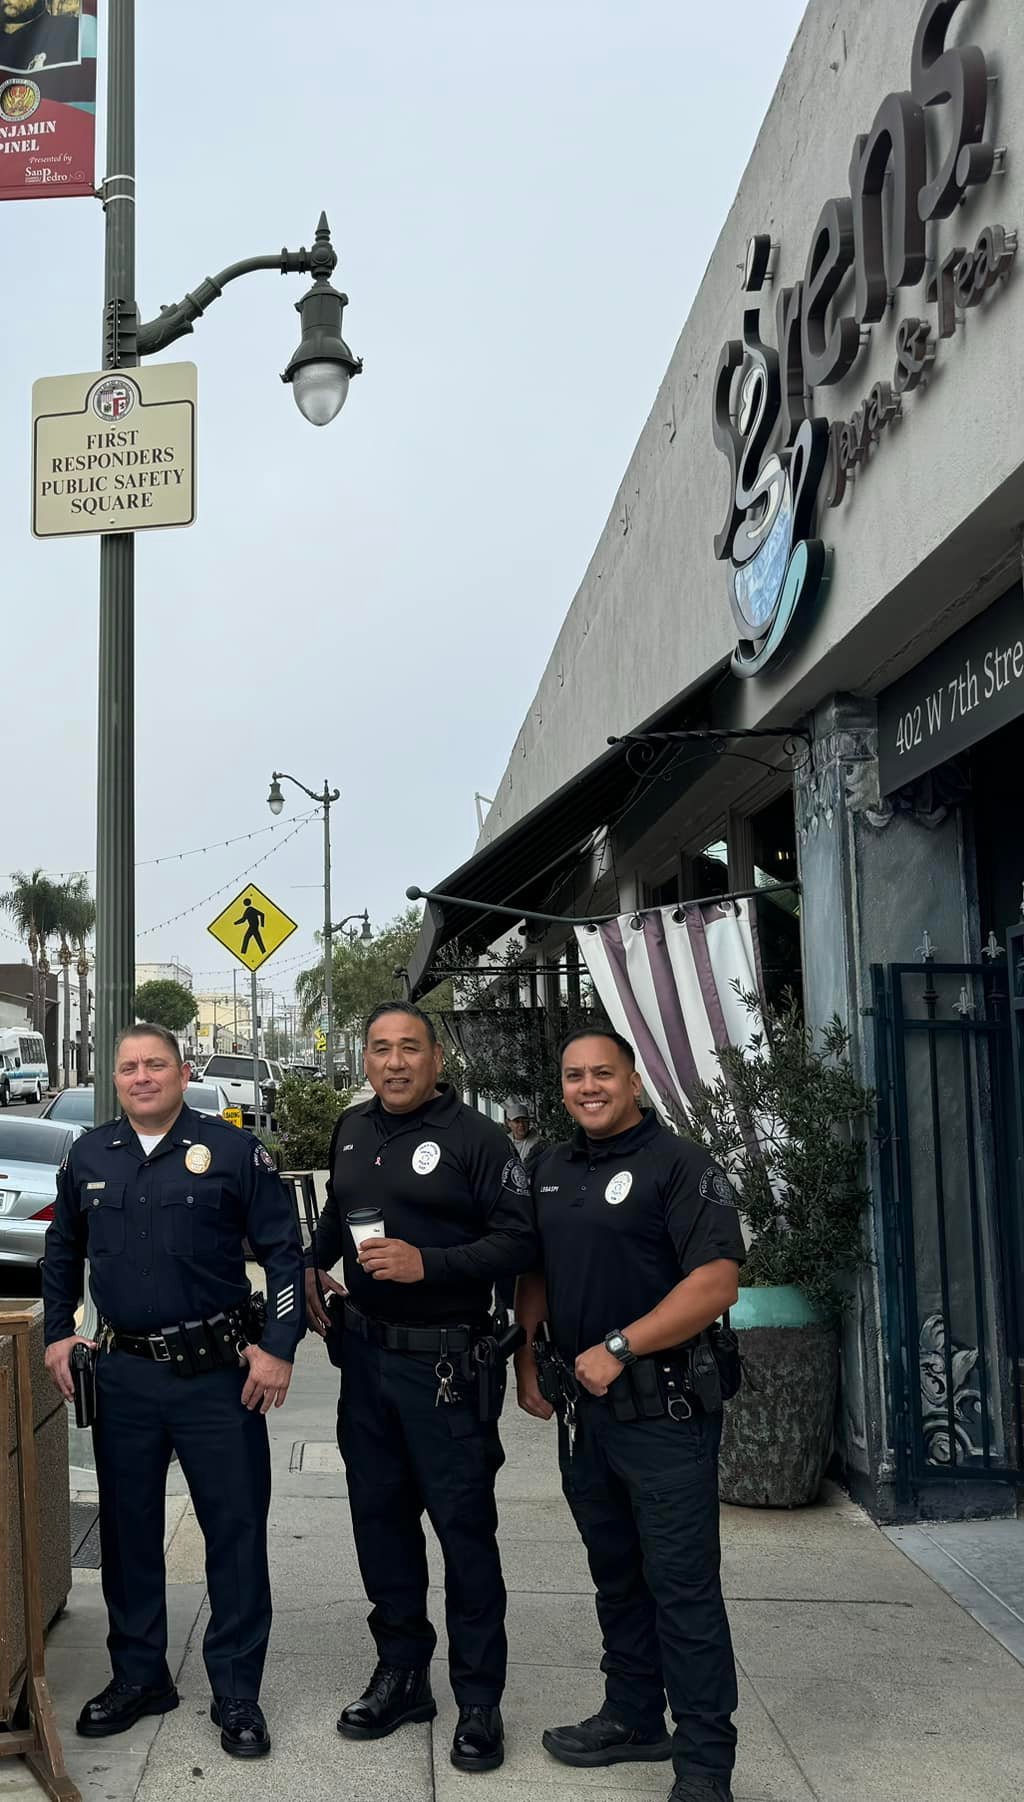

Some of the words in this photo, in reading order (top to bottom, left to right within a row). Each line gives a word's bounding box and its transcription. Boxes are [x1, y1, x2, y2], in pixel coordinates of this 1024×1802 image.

[29, 154, 62, 164] Presented
[63, 153, 73, 163] by
[894, 317, 932, 392] &
[926, 224, 1013, 340] Tea
[87, 430, 139, 450] FIRST
[52, 447, 175, 473] RESPONDERS
[41, 476, 108, 496] PUBLIC
[114, 469, 185, 490] SAFETY
[71, 492, 153, 515] SQUARE
[896, 705, 922, 755] 402
[925, 688, 943, 736] W
[948, 660, 980, 723] 7th
